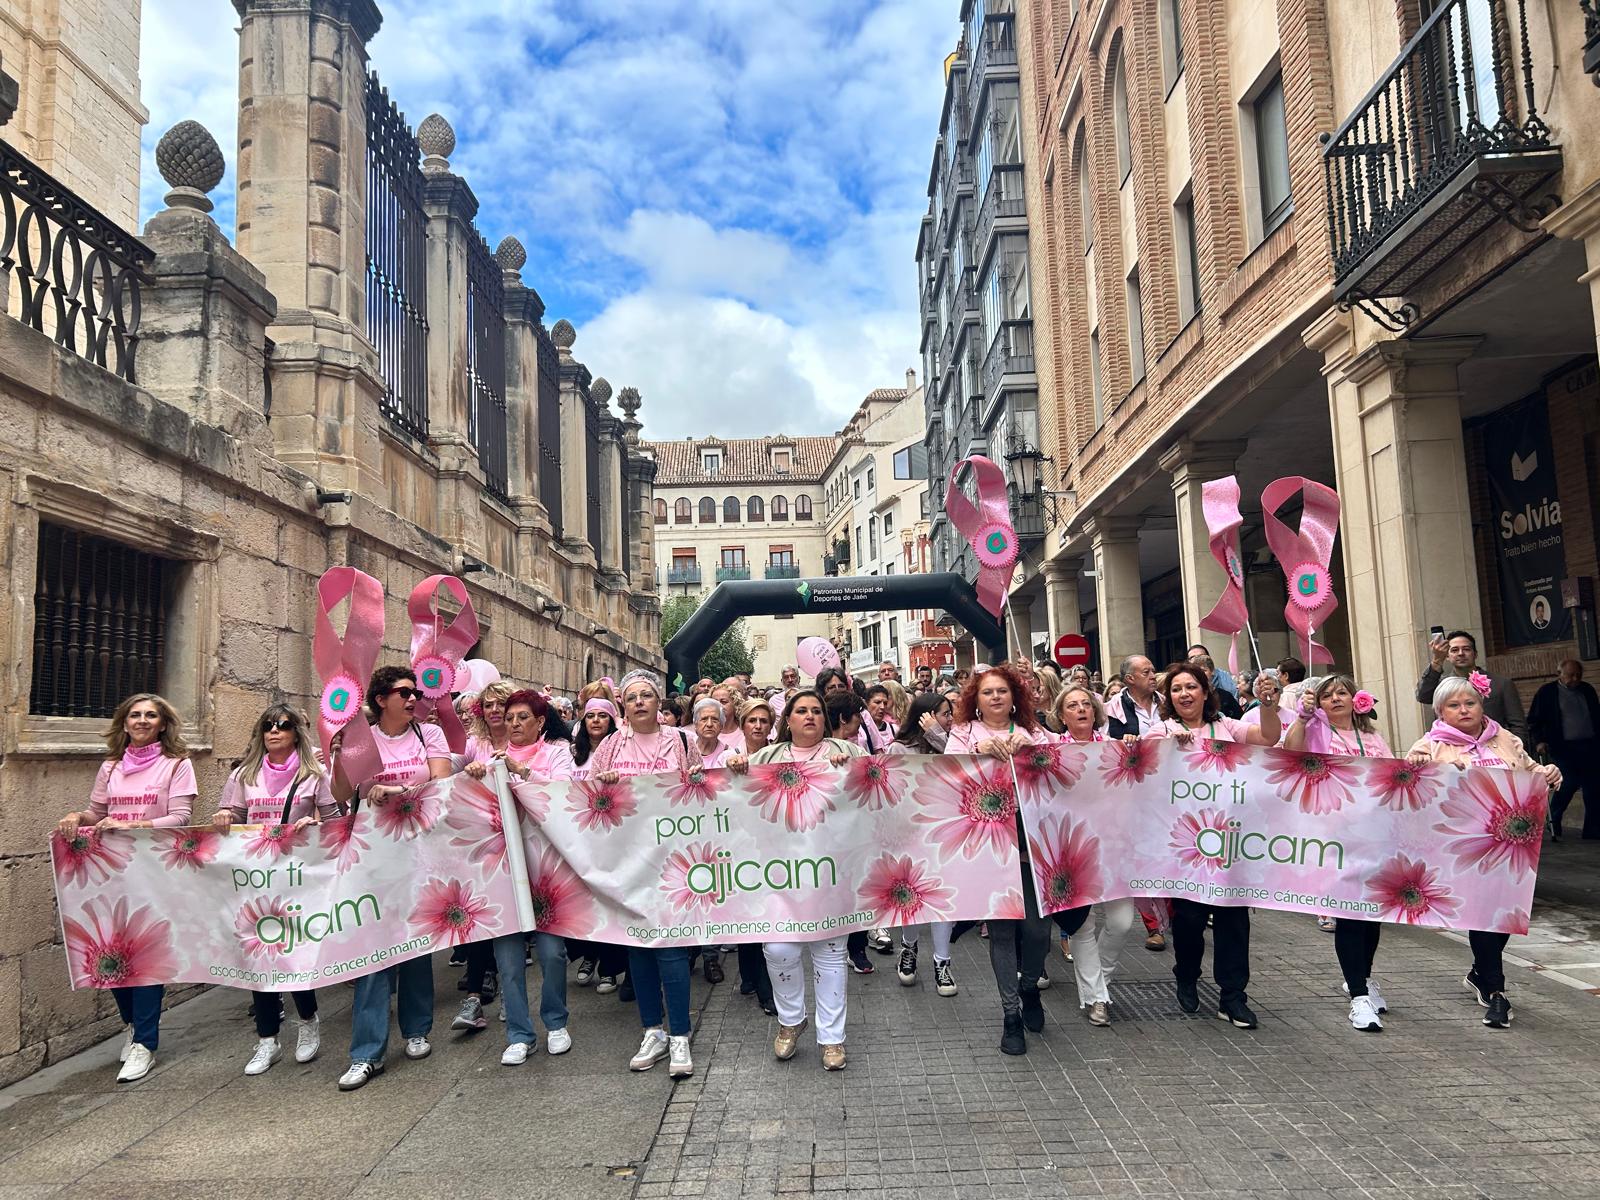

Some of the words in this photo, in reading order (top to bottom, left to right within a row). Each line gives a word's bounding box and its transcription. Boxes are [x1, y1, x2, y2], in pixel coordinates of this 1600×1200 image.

[1501, 497, 1562, 539] Solvia
[1503, 546, 1521, 558] Trato
[1521, 539, 1537, 554] bien
[1538, 535, 1561, 549] hecho
[813, 595, 842, 603] Deportes
[844, 586, 874, 594] Municipal
[1171, 780, 1222, 804] por
[655, 815, 705, 844] por
[1196, 821, 1344, 870] ajicam
[232, 868, 277, 892] por
[687, 851, 837, 904] ajicam
[1129, 877, 1205, 894] asociacion
[1208, 883, 1269, 900] jiennense
[1273, 889, 1318, 906] cáncer
[1320, 895, 1338, 908] de
[1339, 901, 1379, 913] mama
[626, 923, 701, 940] asociacion
[706, 920, 771, 939] jiennense
[775, 919, 820, 933] cáncer
[821, 916, 836, 930] de
[837, 910, 873, 927] mama
[322, 953, 369, 977] cáncer
[370, 949, 388, 964] de
[388, 935, 430, 958] mama
